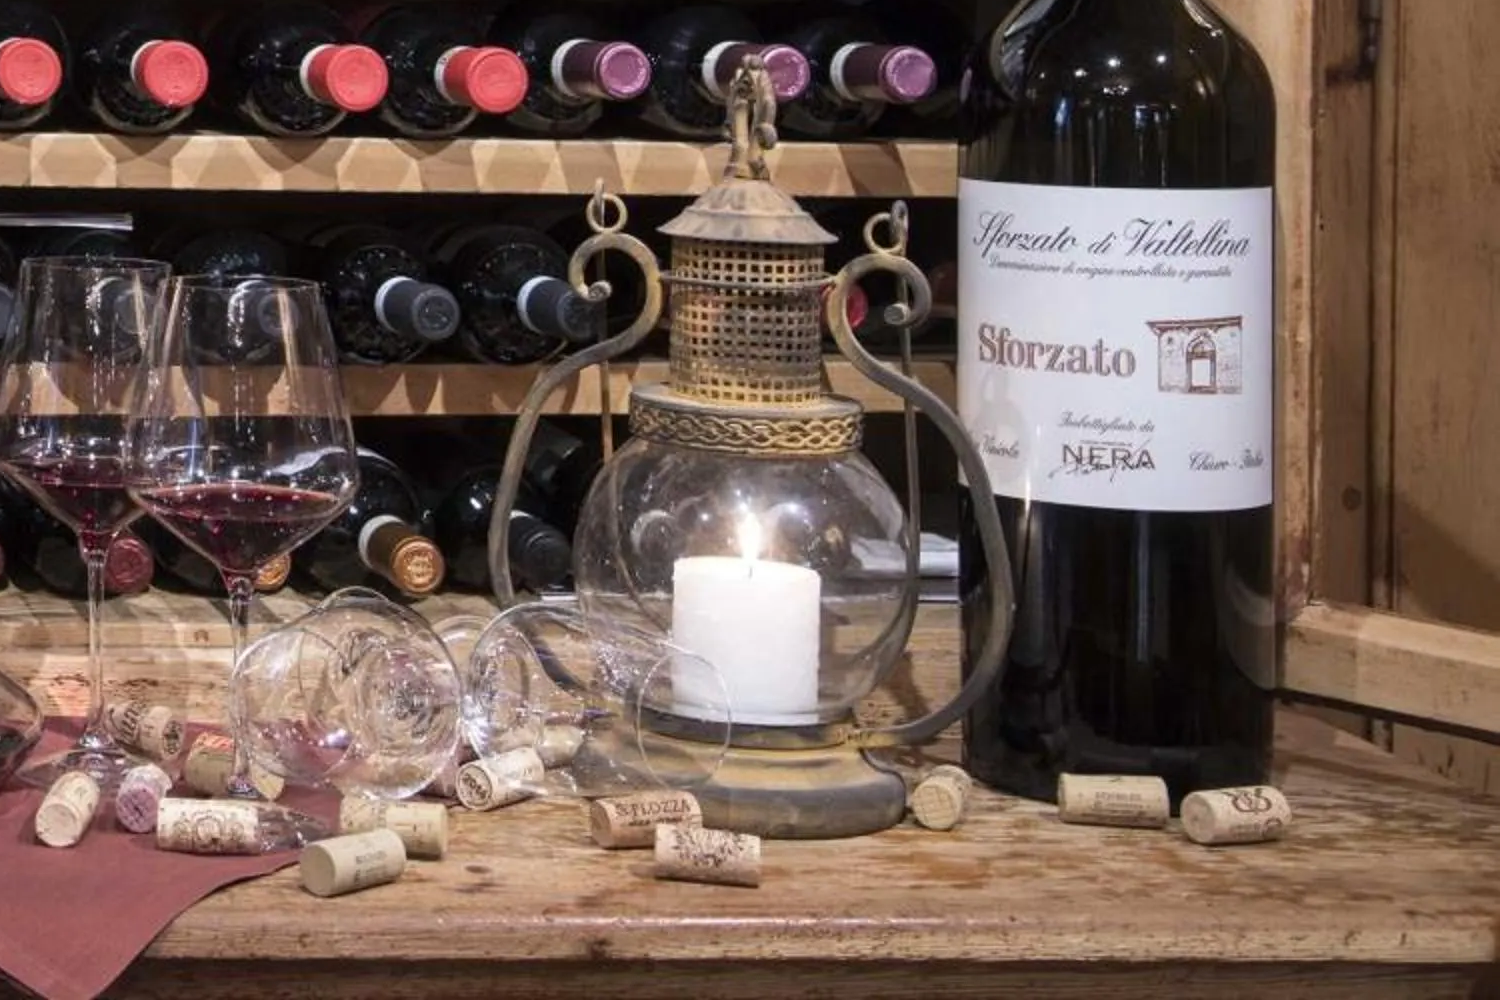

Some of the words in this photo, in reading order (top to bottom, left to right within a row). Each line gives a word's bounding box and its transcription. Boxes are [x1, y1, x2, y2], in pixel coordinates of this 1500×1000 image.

[972, 210, 1077, 259] Sforzato
[1087, 232, 1117, 256] di
[1120, 216, 1252, 258] Valtellina
[977, 321, 1137, 378] Sforzato
[1061, 444, 1157, 471] NERA
[630, 798, 692, 817] PLOZZA
